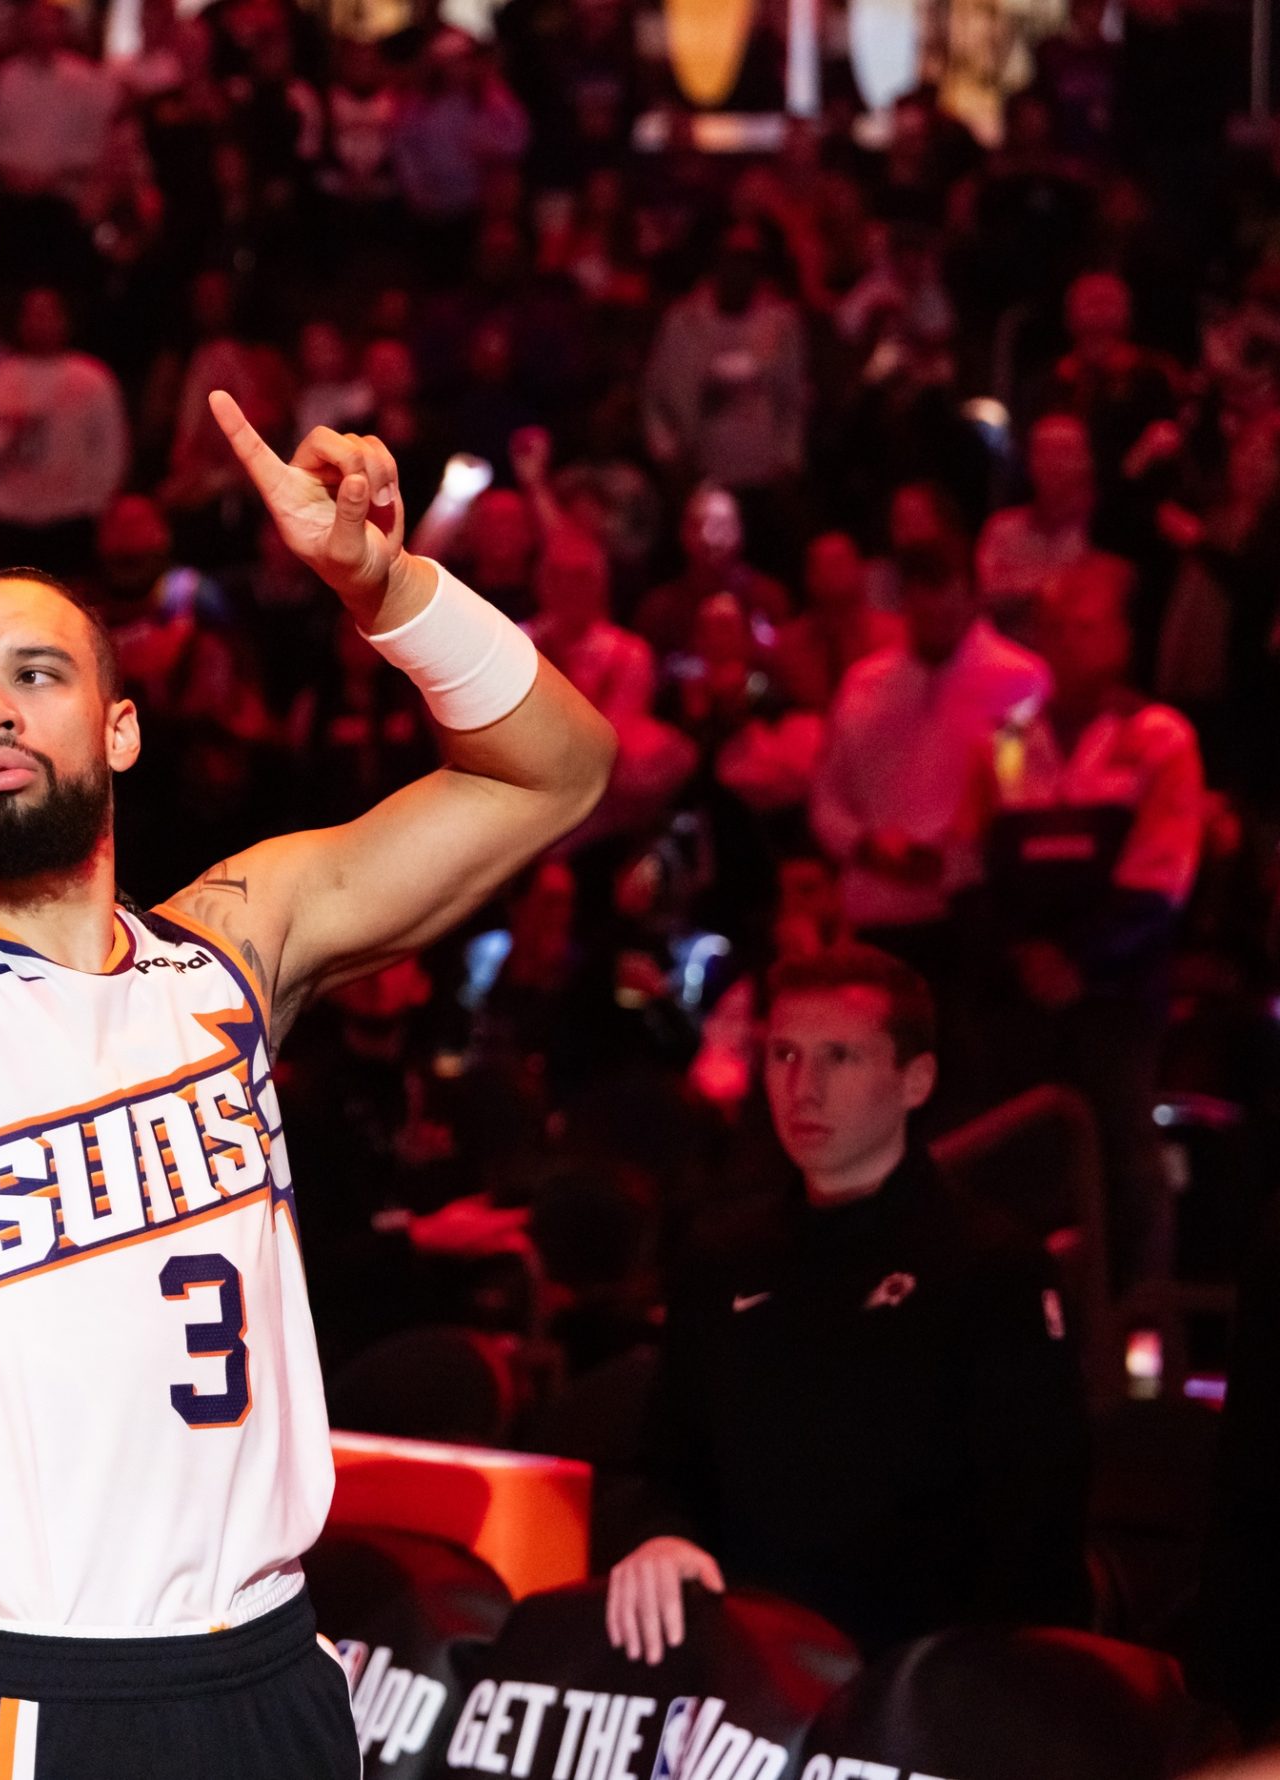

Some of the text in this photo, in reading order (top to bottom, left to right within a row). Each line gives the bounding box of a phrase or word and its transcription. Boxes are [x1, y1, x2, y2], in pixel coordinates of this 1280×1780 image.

[159, 1253, 253, 1430] 3
[447, 1679, 559, 1778] GET
[552, 1689, 657, 1780] THE
